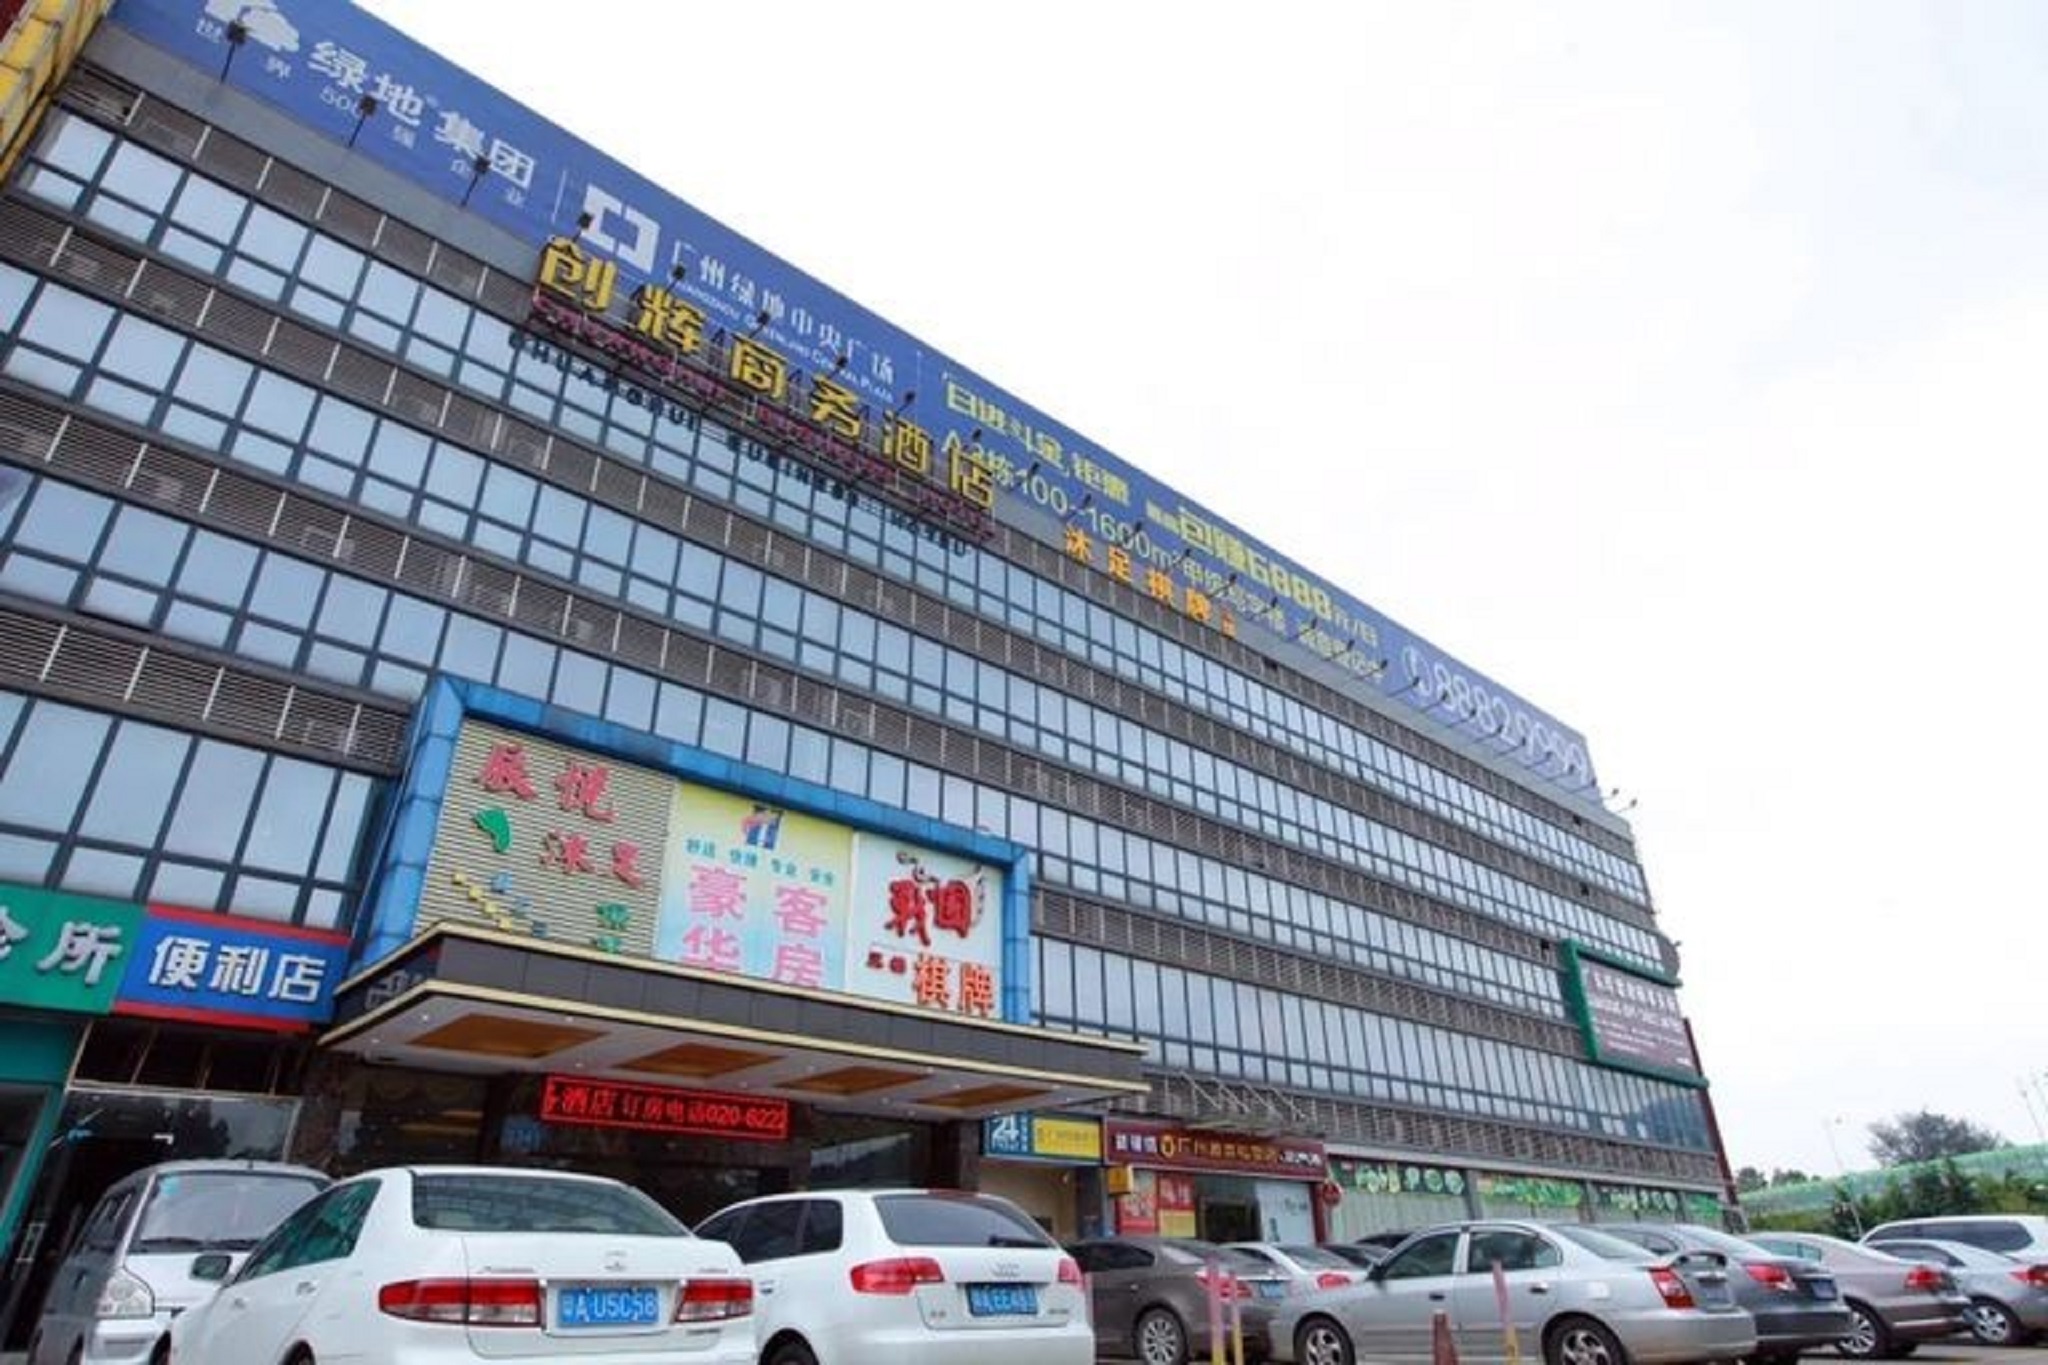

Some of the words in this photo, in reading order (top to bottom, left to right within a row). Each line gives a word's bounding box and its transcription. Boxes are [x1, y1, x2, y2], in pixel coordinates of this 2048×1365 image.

[308, 41, 535, 189] 绿地集团
[672, 240, 894, 385] 广州绿地中央广场
[540, 235, 992, 510] 创辉商务酒店
[148, 935, 327, 1002] 便利店
[682, 865, 747, 973] 豪华
[772, 885, 828, 989] 客房
[911, 953, 996, 1017] 棋牌
